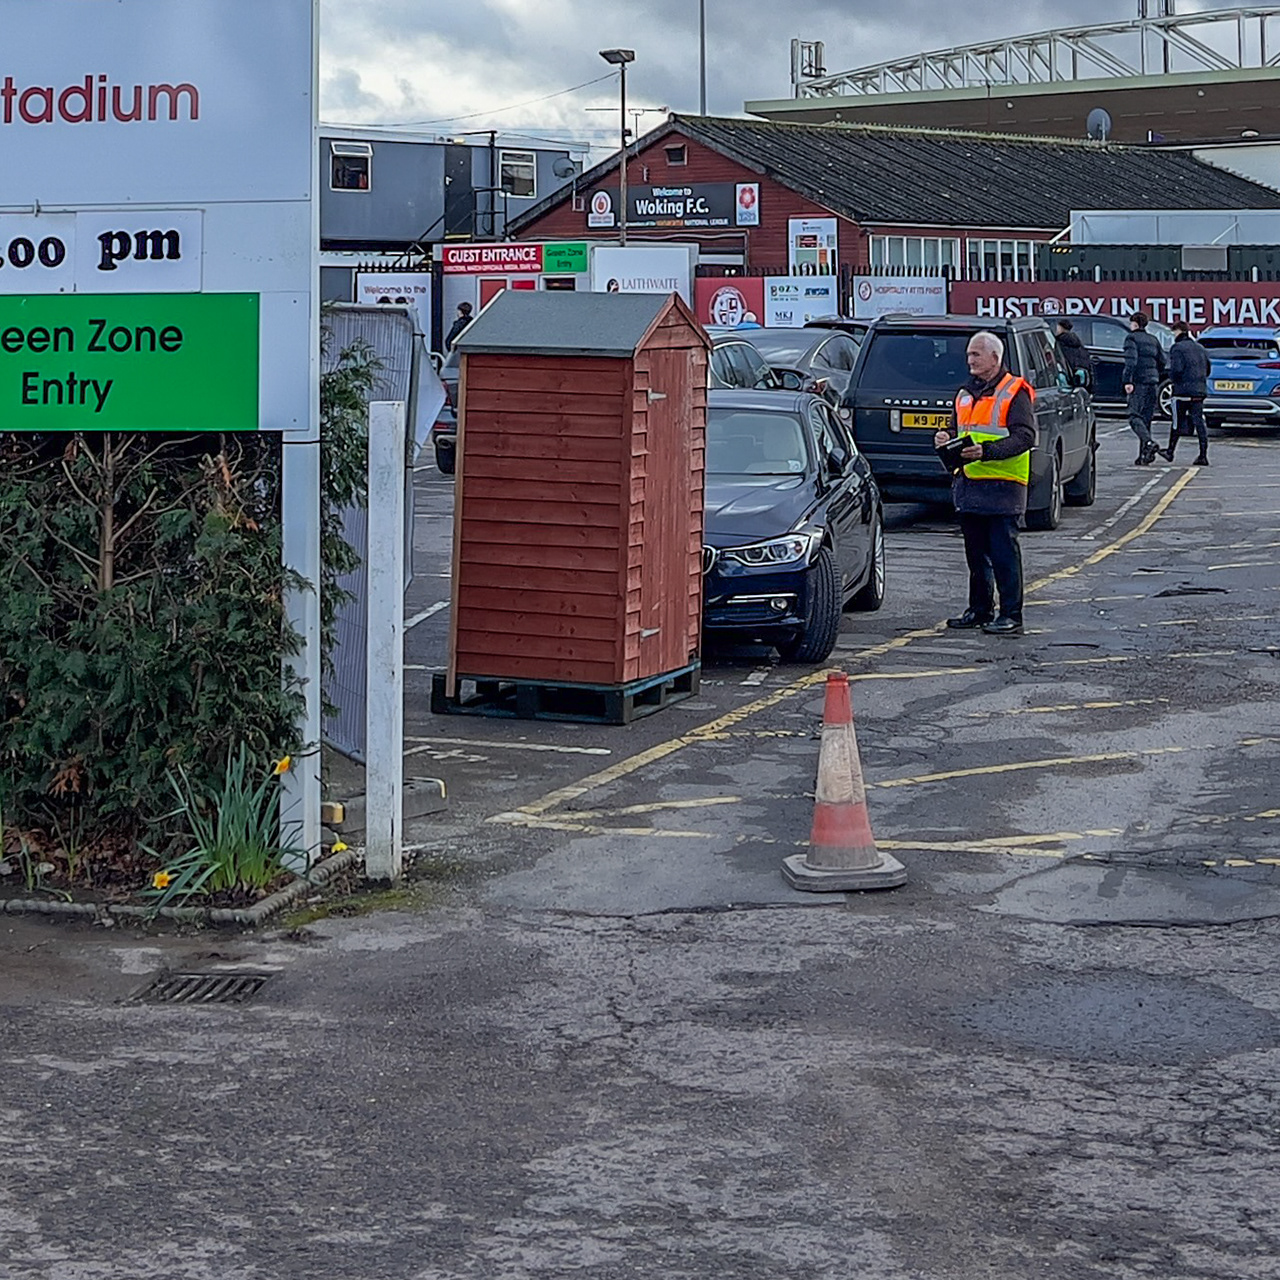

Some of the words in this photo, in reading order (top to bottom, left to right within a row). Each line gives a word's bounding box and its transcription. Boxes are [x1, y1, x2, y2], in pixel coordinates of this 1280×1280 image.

[652, 187, 683, 197] Welcome
[684, 188, 692, 196] to
[635, 199, 684, 217] Woking
[686, 198, 709, 214] F.C.
[97, 227, 181, 270] pm
[448, 249, 480, 262] GUEST
[482, 248, 536, 262] ENTRANCE
[364, 286, 402, 294] Welcome
[622, 278, 679, 290] LAITHWAITE
[1111, 297, 1140, 316] IN
[1146, 298, 1206, 324] THE
[88, 318, 183, 353] Zone
[22, 372, 113, 412] Entry
